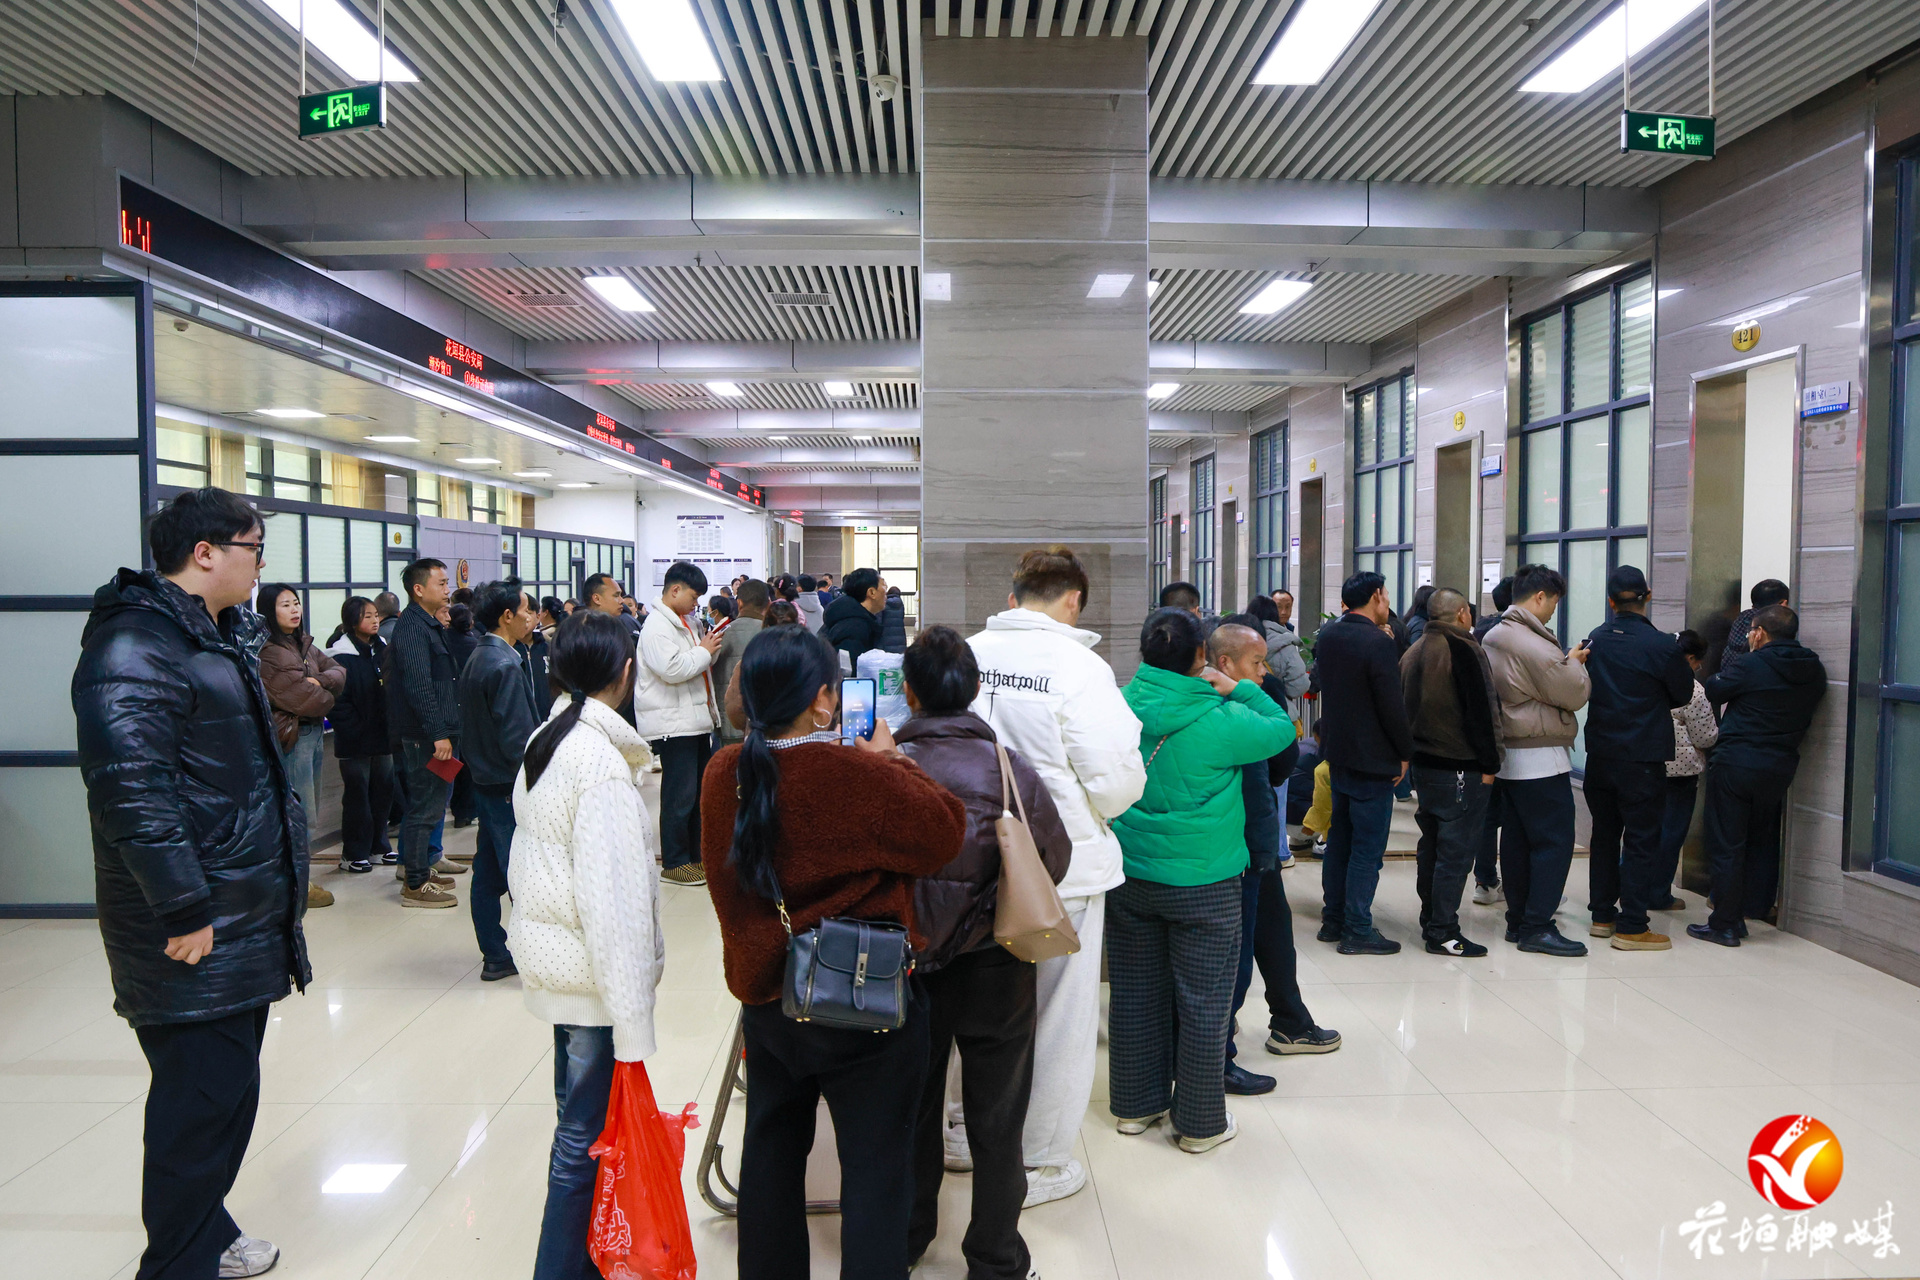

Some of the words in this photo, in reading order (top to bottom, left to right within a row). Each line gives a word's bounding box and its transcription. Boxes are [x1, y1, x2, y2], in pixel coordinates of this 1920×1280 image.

[1737, 328, 1754, 344] 421
[445, 338, 483, 371] 花垣县公安局
